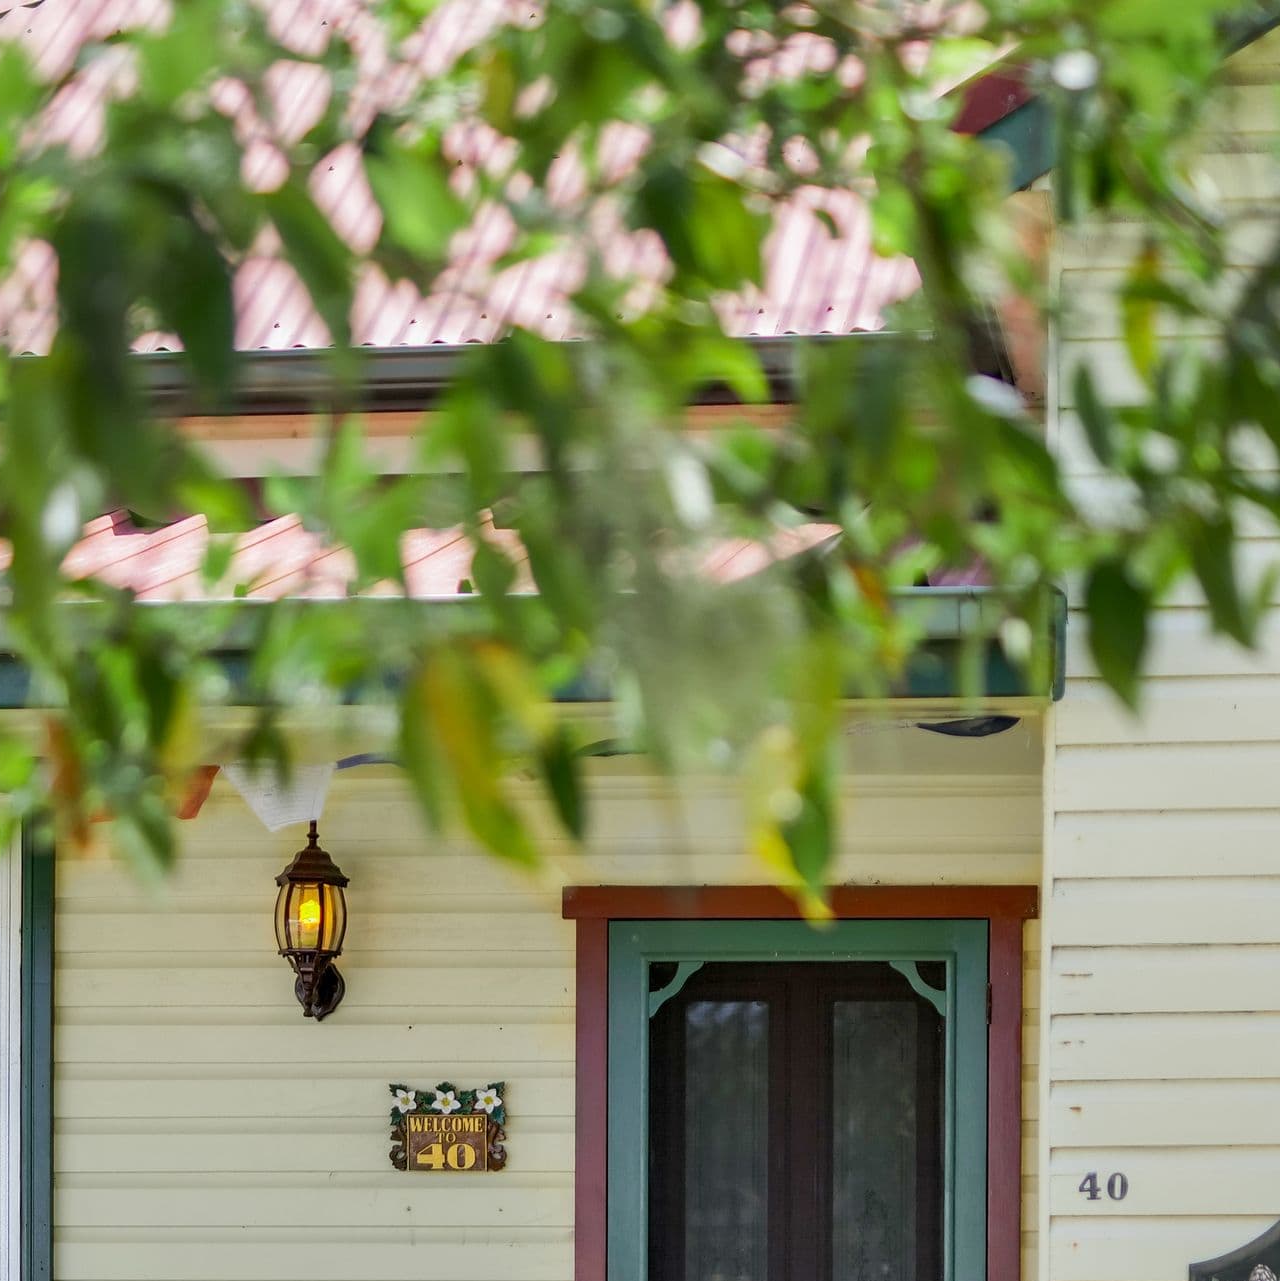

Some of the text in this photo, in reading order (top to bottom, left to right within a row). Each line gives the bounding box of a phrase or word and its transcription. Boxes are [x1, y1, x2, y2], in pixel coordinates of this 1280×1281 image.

[409, 1117, 483, 1133] WELCOME
[436, 1132, 457, 1143] TO
[417, 1143, 476, 1170] 40
[1078, 1171, 1129, 1201] 40
